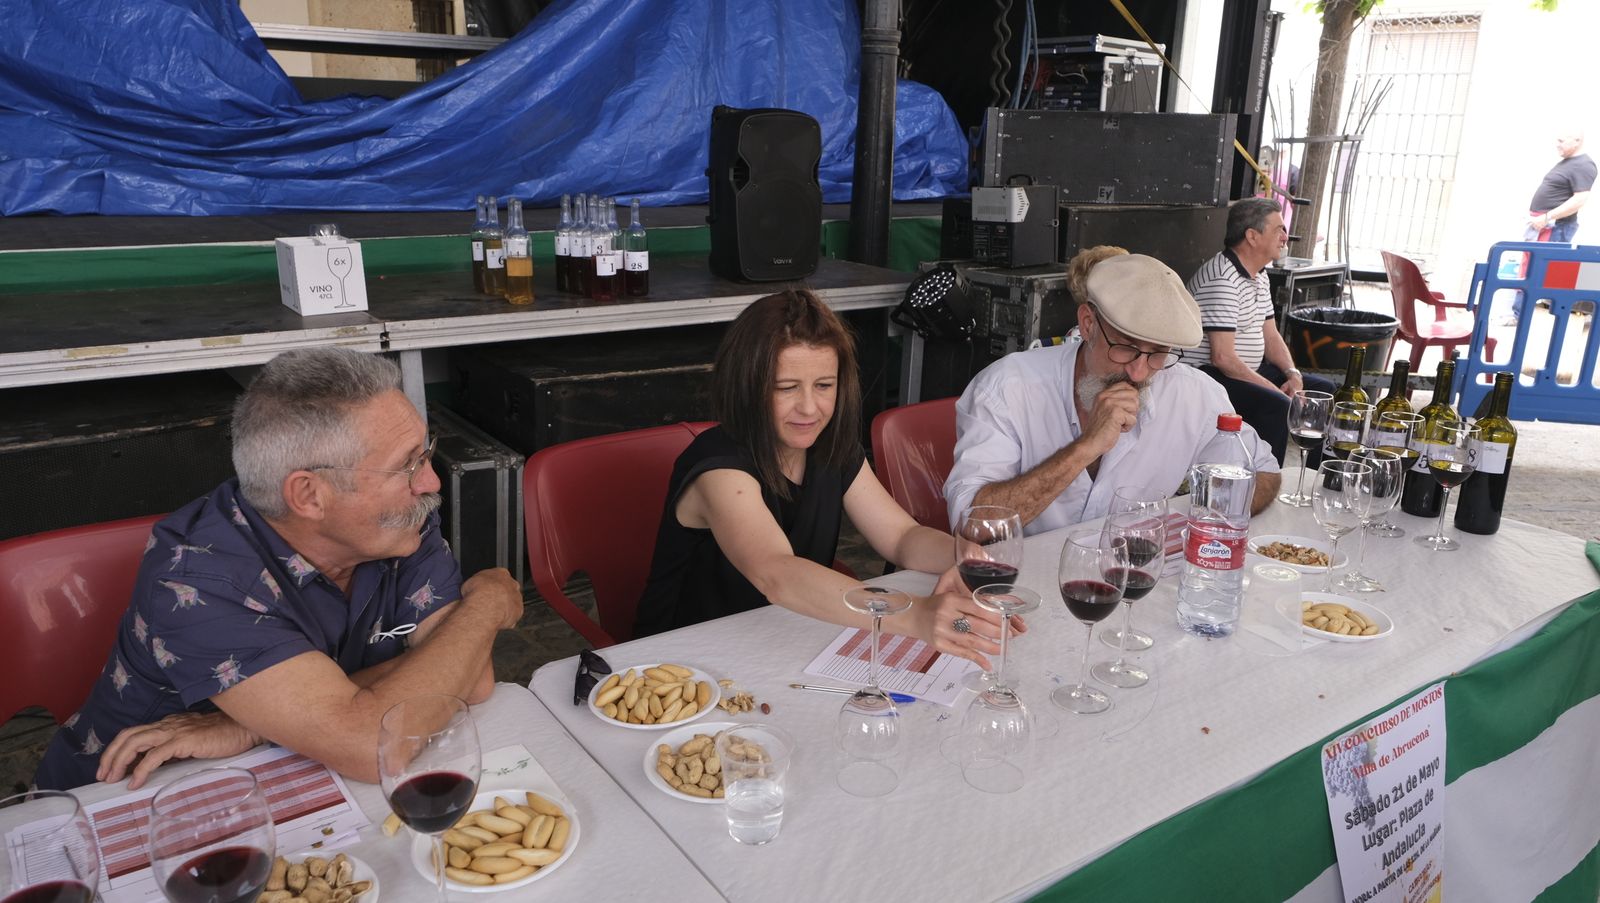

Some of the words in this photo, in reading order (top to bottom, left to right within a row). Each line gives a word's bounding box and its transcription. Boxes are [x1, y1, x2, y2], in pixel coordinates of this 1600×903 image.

[1261, 26, 1271, 57] TOWER
[1258, 58, 1267, 87] SUPER
[333, 257, 346, 266] 6x
[309, 284, 333, 293] VINO
[1344, 713, 1400, 751] CONCURSO
[1400, 705, 1411, 723] DE
[1411, 687, 1443, 716] MOSTOS
[1378, 752, 1390, 768] de
[1344, 793, 1391, 830] Sábado
[1391, 782, 1405, 804] 21
[1406, 774, 1418, 794] de
[1418, 756, 1440, 784] Mayo
[1361, 818, 1398, 852] Lugar:
[1398, 798, 1424, 828] Plaza
[1424, 787, 1434, 807] de
